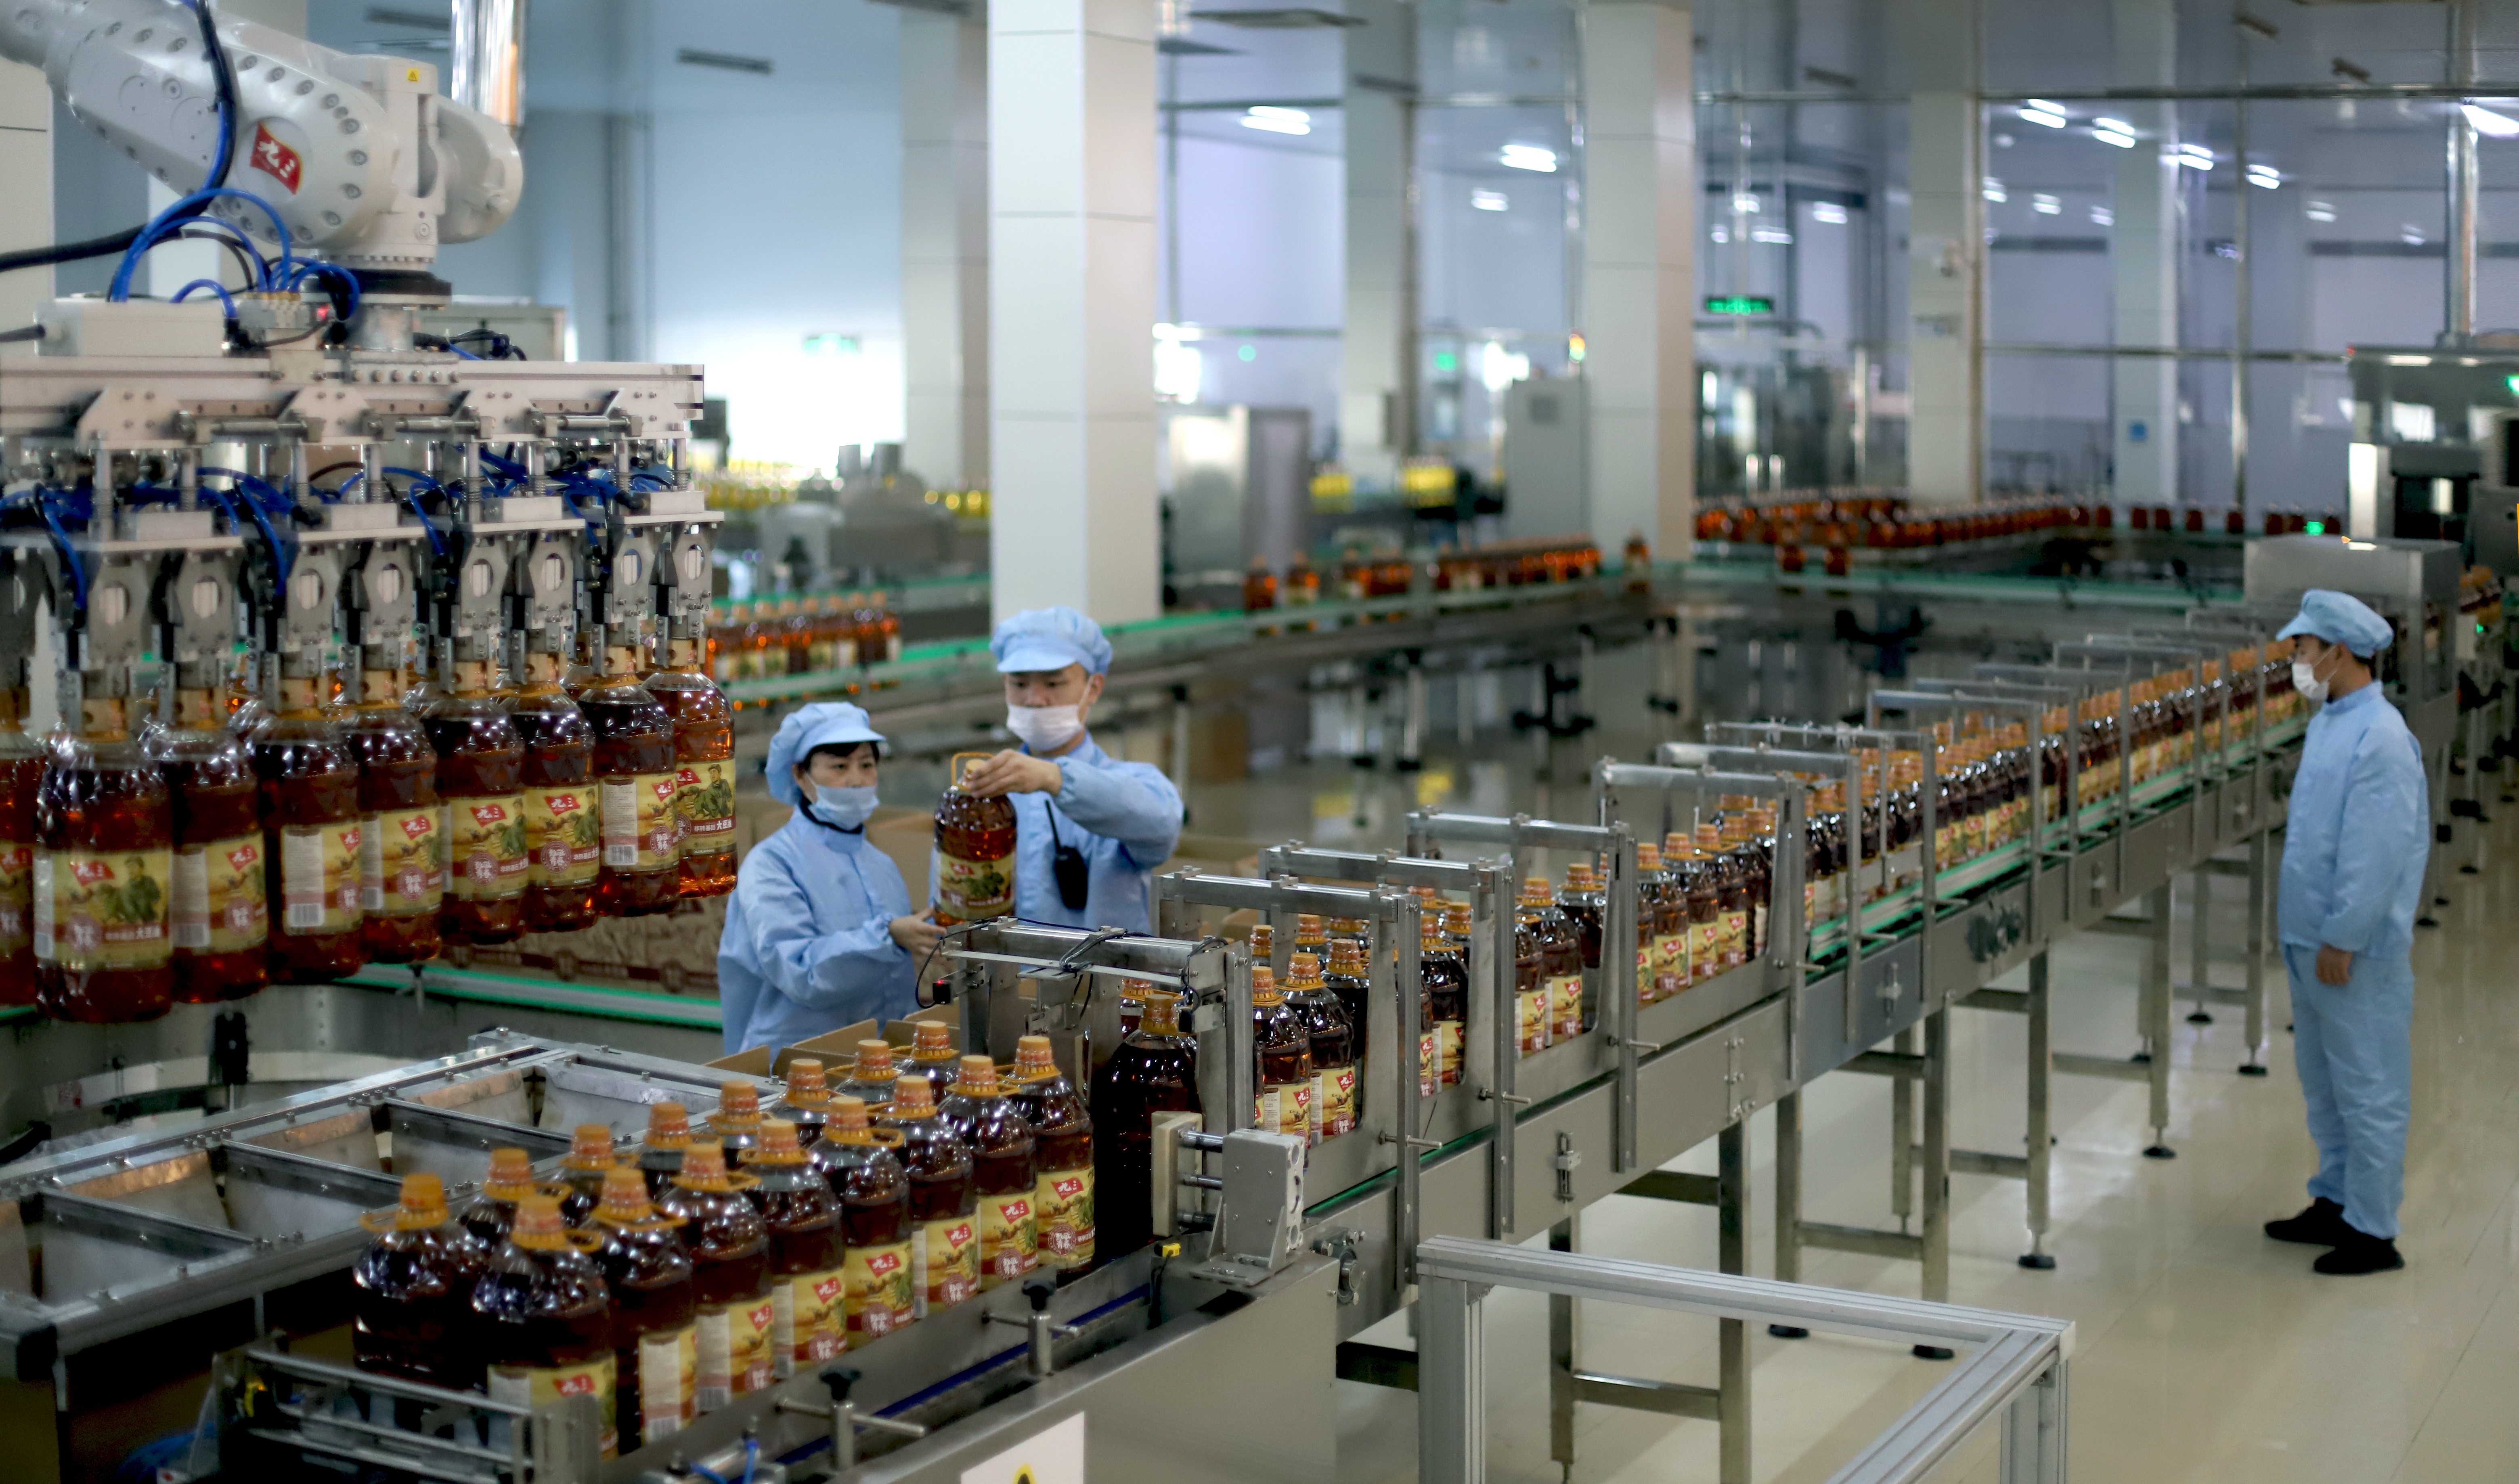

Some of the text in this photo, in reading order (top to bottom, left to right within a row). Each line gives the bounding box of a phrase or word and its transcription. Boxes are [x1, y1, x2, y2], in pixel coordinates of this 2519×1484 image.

[257, 140, 295, 178] 九三
[658, 782, 672, 794] 九三
[551, 797, 573, 808] 九三
[476, 807, 500, 819] 九三
[406, 819, 426, 832] 九三
[1340, 1074, 1352, 1086] 九三
[1297, 1090, 1310, 1102] 九三
[1058, 1180, 1077, 1192] 九三
[1005, 1203, 1025, 1216] 九三
[950, 1227, 968, 1241] 九三
[872, 1256, 894, 1270] 九三
